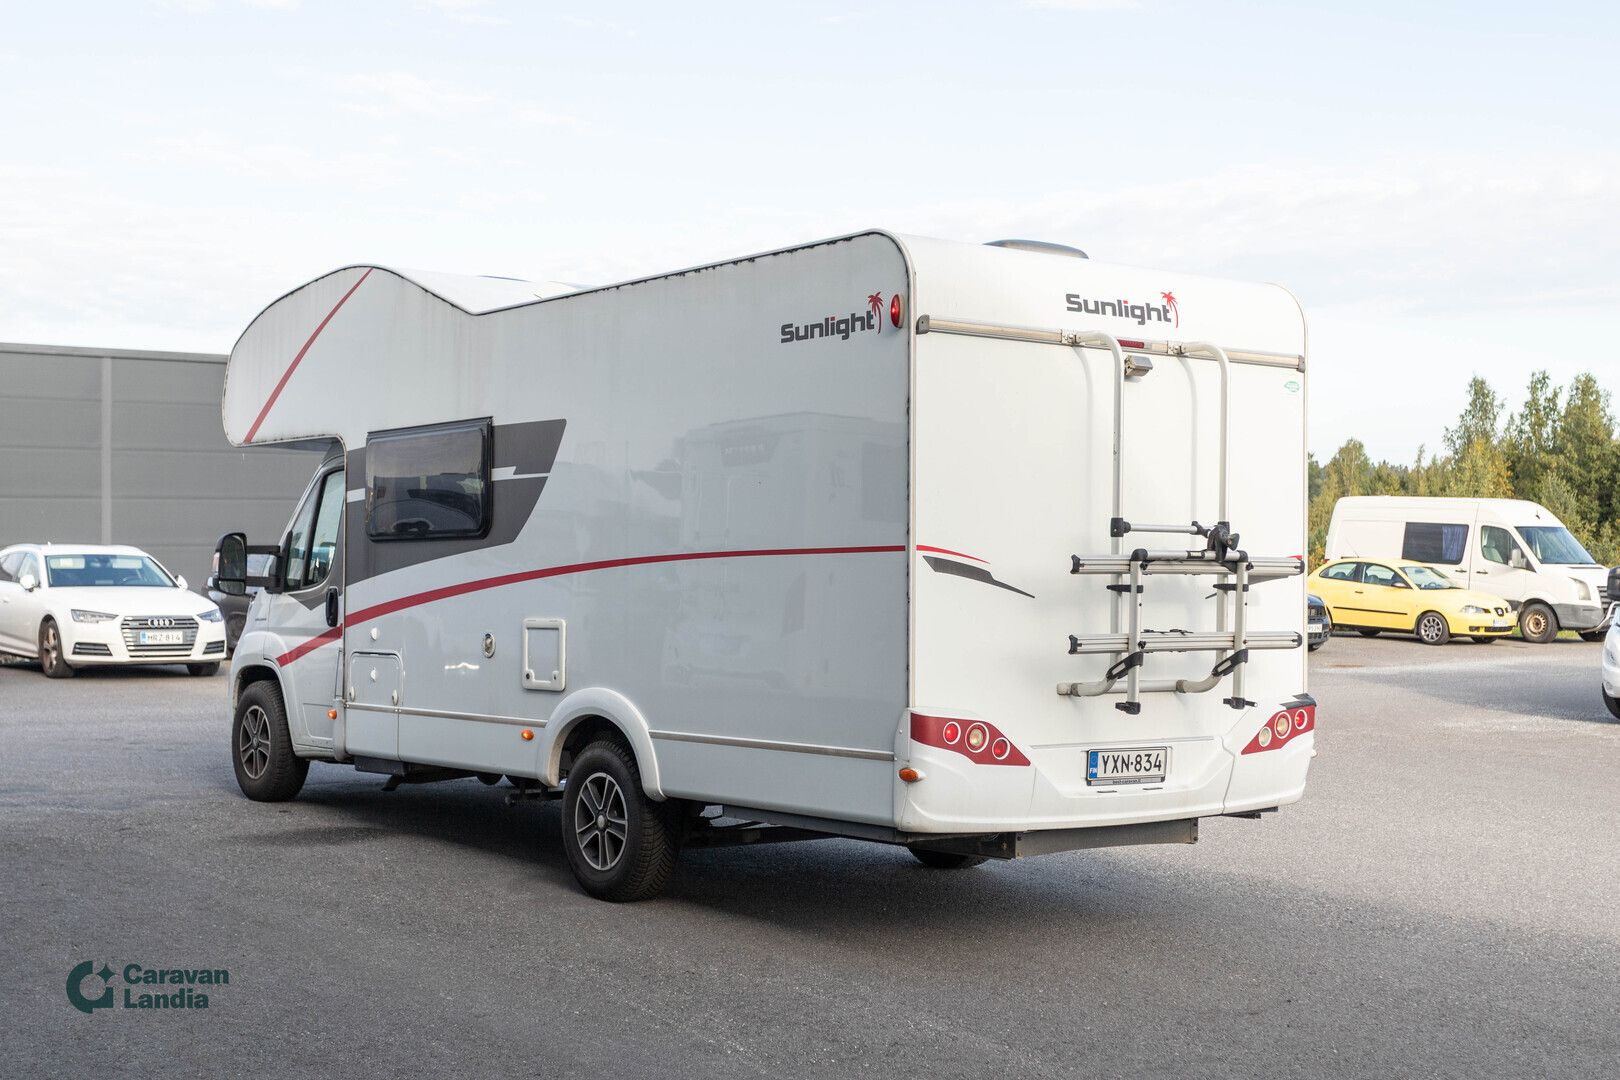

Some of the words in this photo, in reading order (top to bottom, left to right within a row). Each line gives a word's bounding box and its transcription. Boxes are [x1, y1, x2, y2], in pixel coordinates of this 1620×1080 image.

[1065, 293, 1172, 326] Sunlight
[780, 310, 875, 344] Sunlight
[1102, 753, 1162, 774] YXN-834
